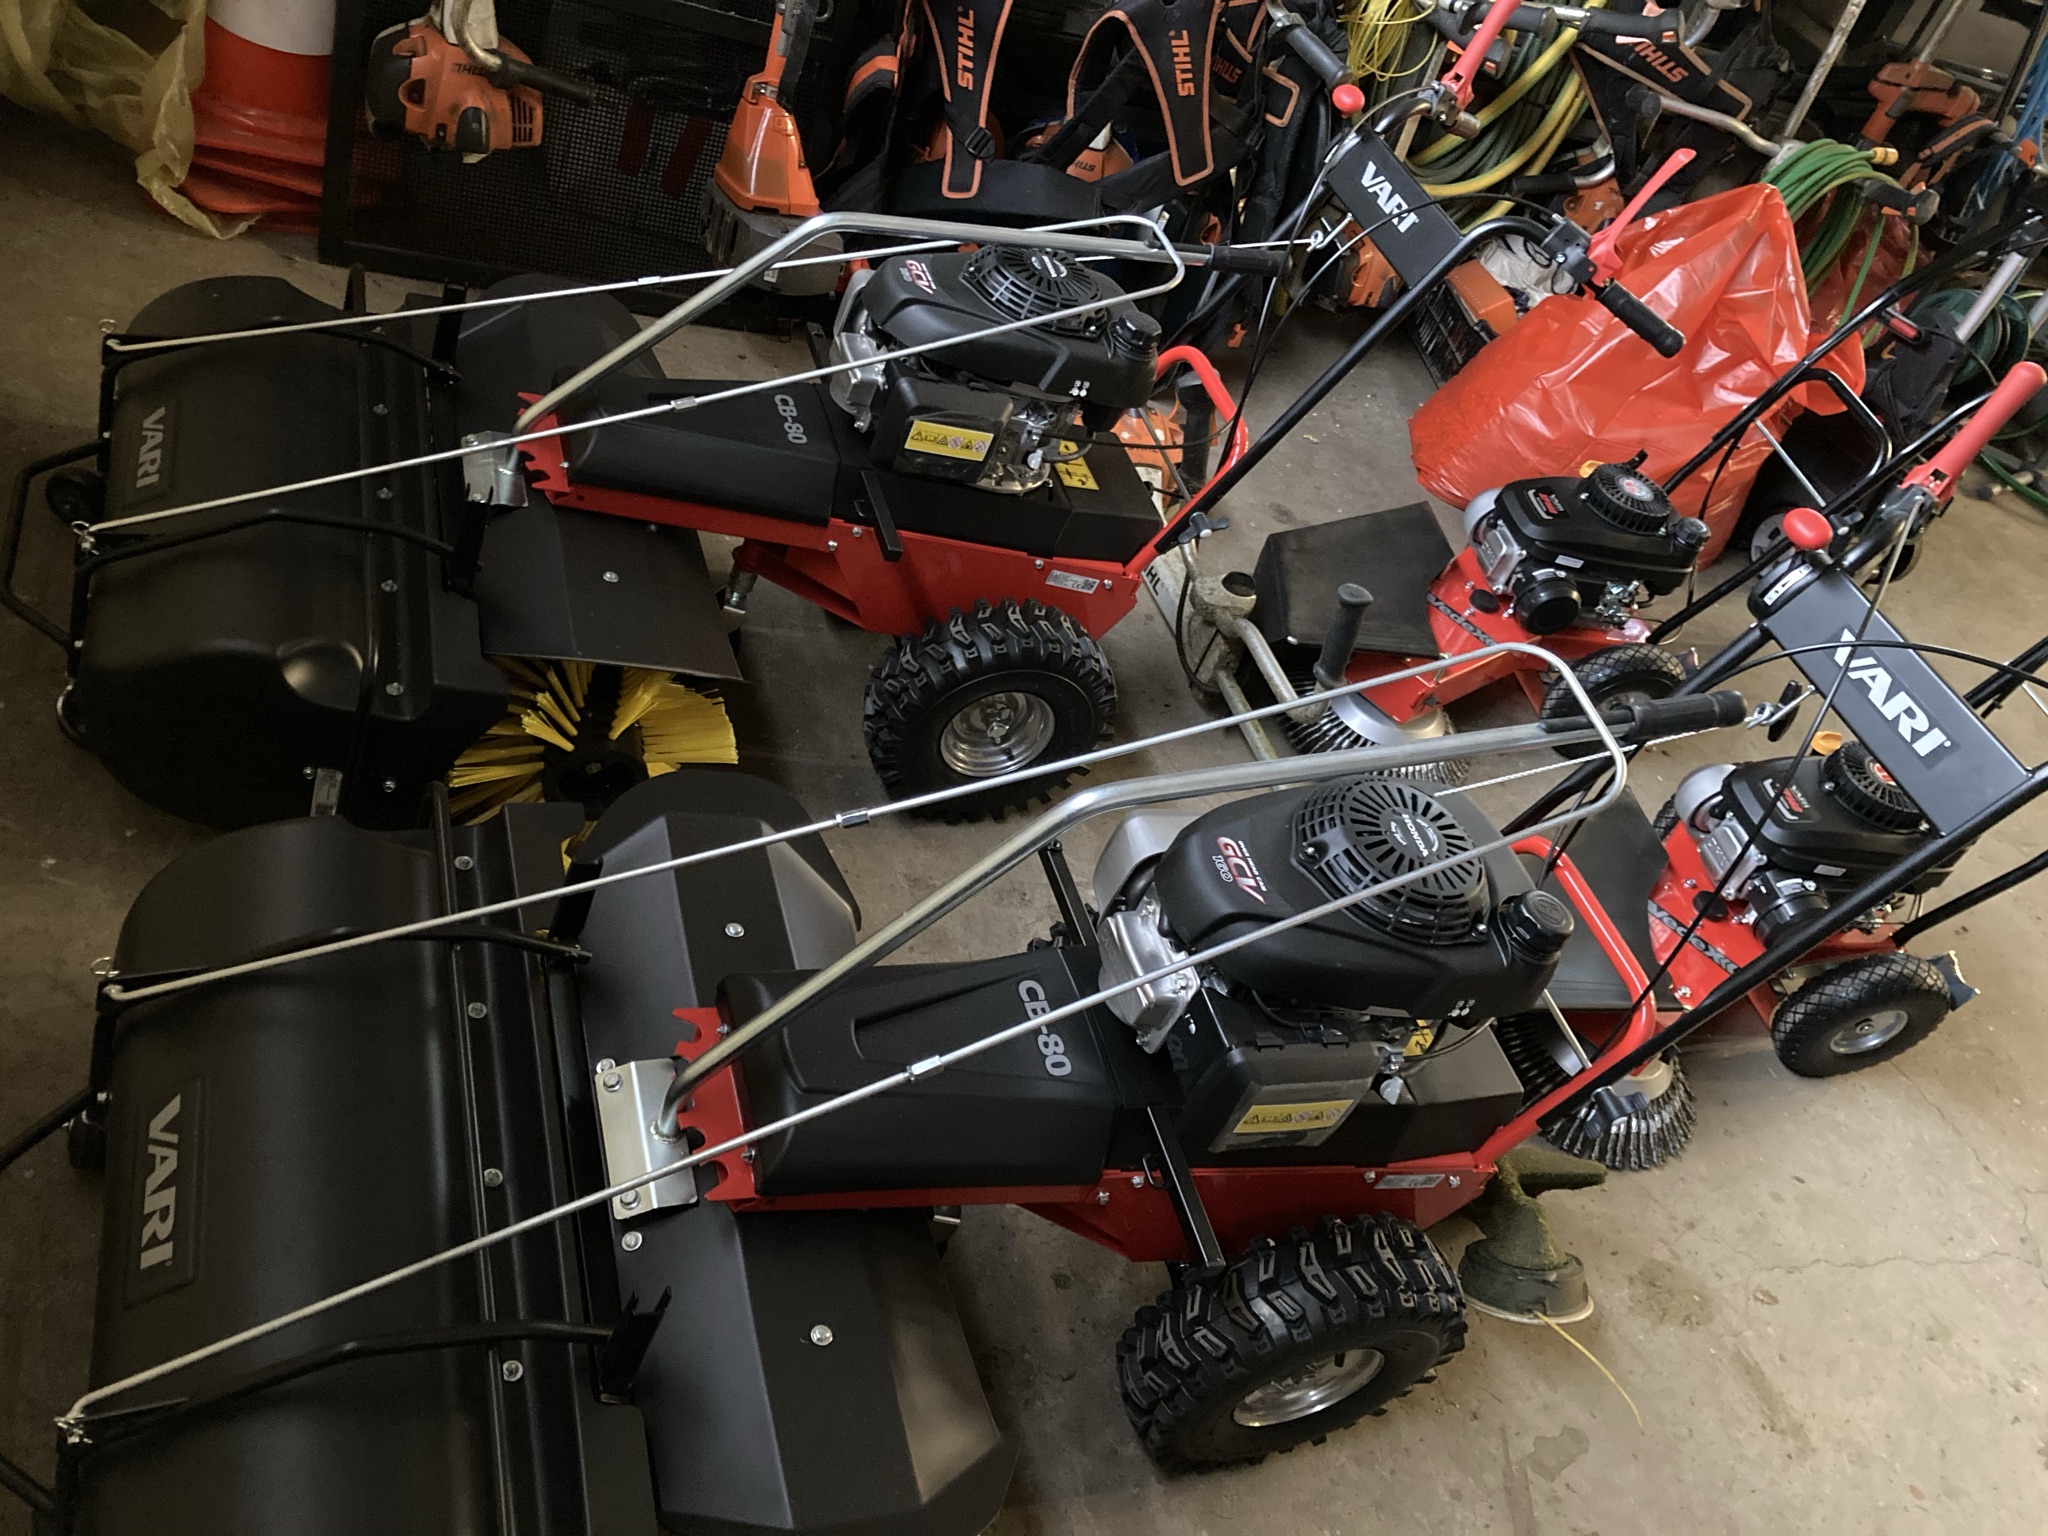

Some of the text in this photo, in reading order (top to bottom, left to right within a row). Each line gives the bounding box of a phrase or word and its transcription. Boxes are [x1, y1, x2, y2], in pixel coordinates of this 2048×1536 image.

[957, 8, 974, 90] STIHL
[1170, 29, 1195, 96] STIHL
[1073, 160, 1096, 172] STIH
[1361, 161, 1419, 233] VARI
[904, 259, 934, 295] GCV
[136, 406, 166, 488] VARI
[774, 394, 808, 444] CB-80
[1833, 628, 1948, 757] VARI
[1211, 855, 1234, 882] 160
[1246, 857, 1260, 876] HEAD
[1401, 813, 1429, 857] HONDA
[1217, 836, 1267, 905] GCV
[1018, 979, 1072, 1076] CB-80
[140, 1093, 182, 1270] VARI
